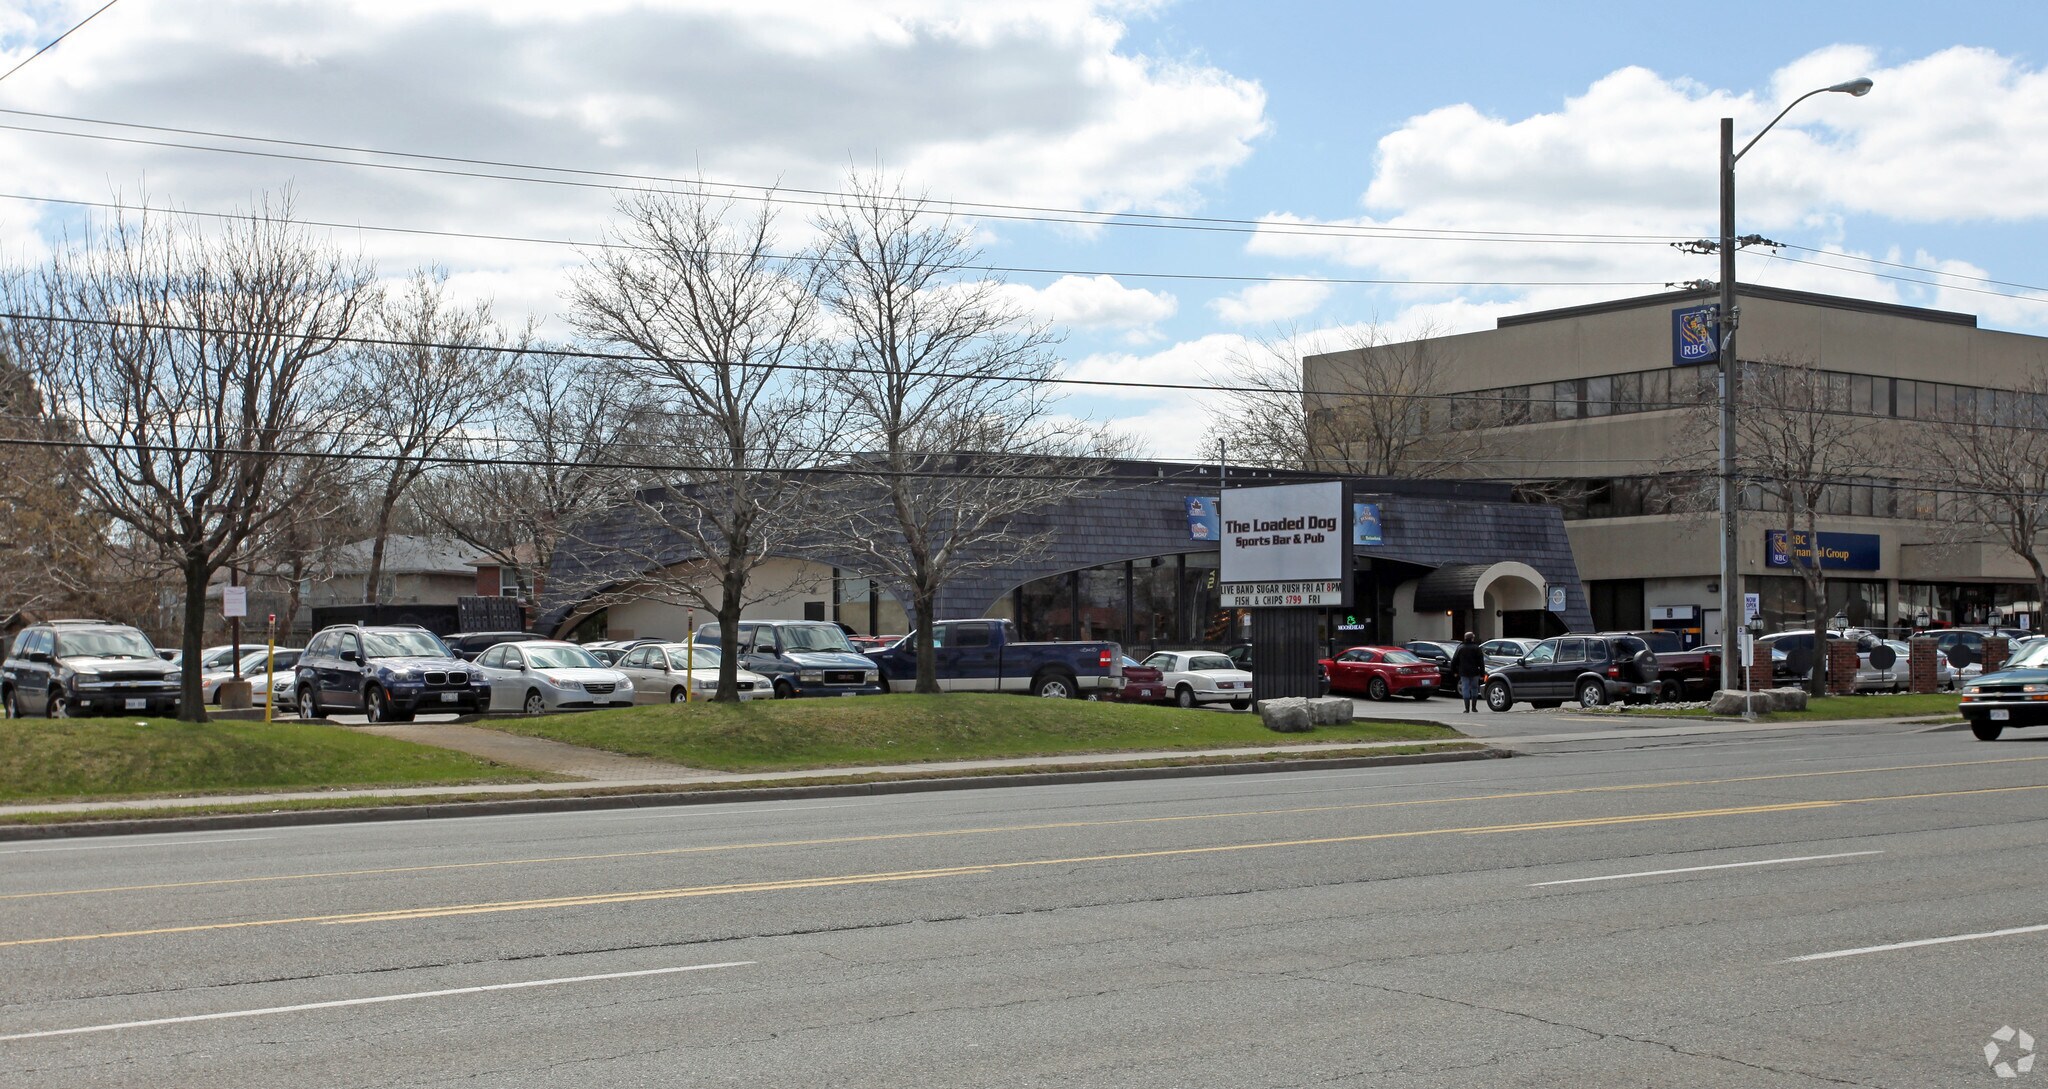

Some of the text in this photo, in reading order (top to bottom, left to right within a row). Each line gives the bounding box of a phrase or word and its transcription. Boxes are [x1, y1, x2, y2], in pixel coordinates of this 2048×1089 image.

[1684, 344, 1706, 355] RBC
[1225, 521, 1249, 533] The
[1253, 517, 1304, 532] Loaded
[1308, 516, 1336, 531] Dog
[1235, 533, 1325, 549] Sports Bar & Pub
[1793, 535, 1806, 545] BC
[1826, 548, 1849, 562] Group
[1221, 582, 1341, 595] LIVE BAND SUGAR RUSH FRI AT 8PM
[1235, 594, 1320, 605] FISH & CHIPS $799 FRI
